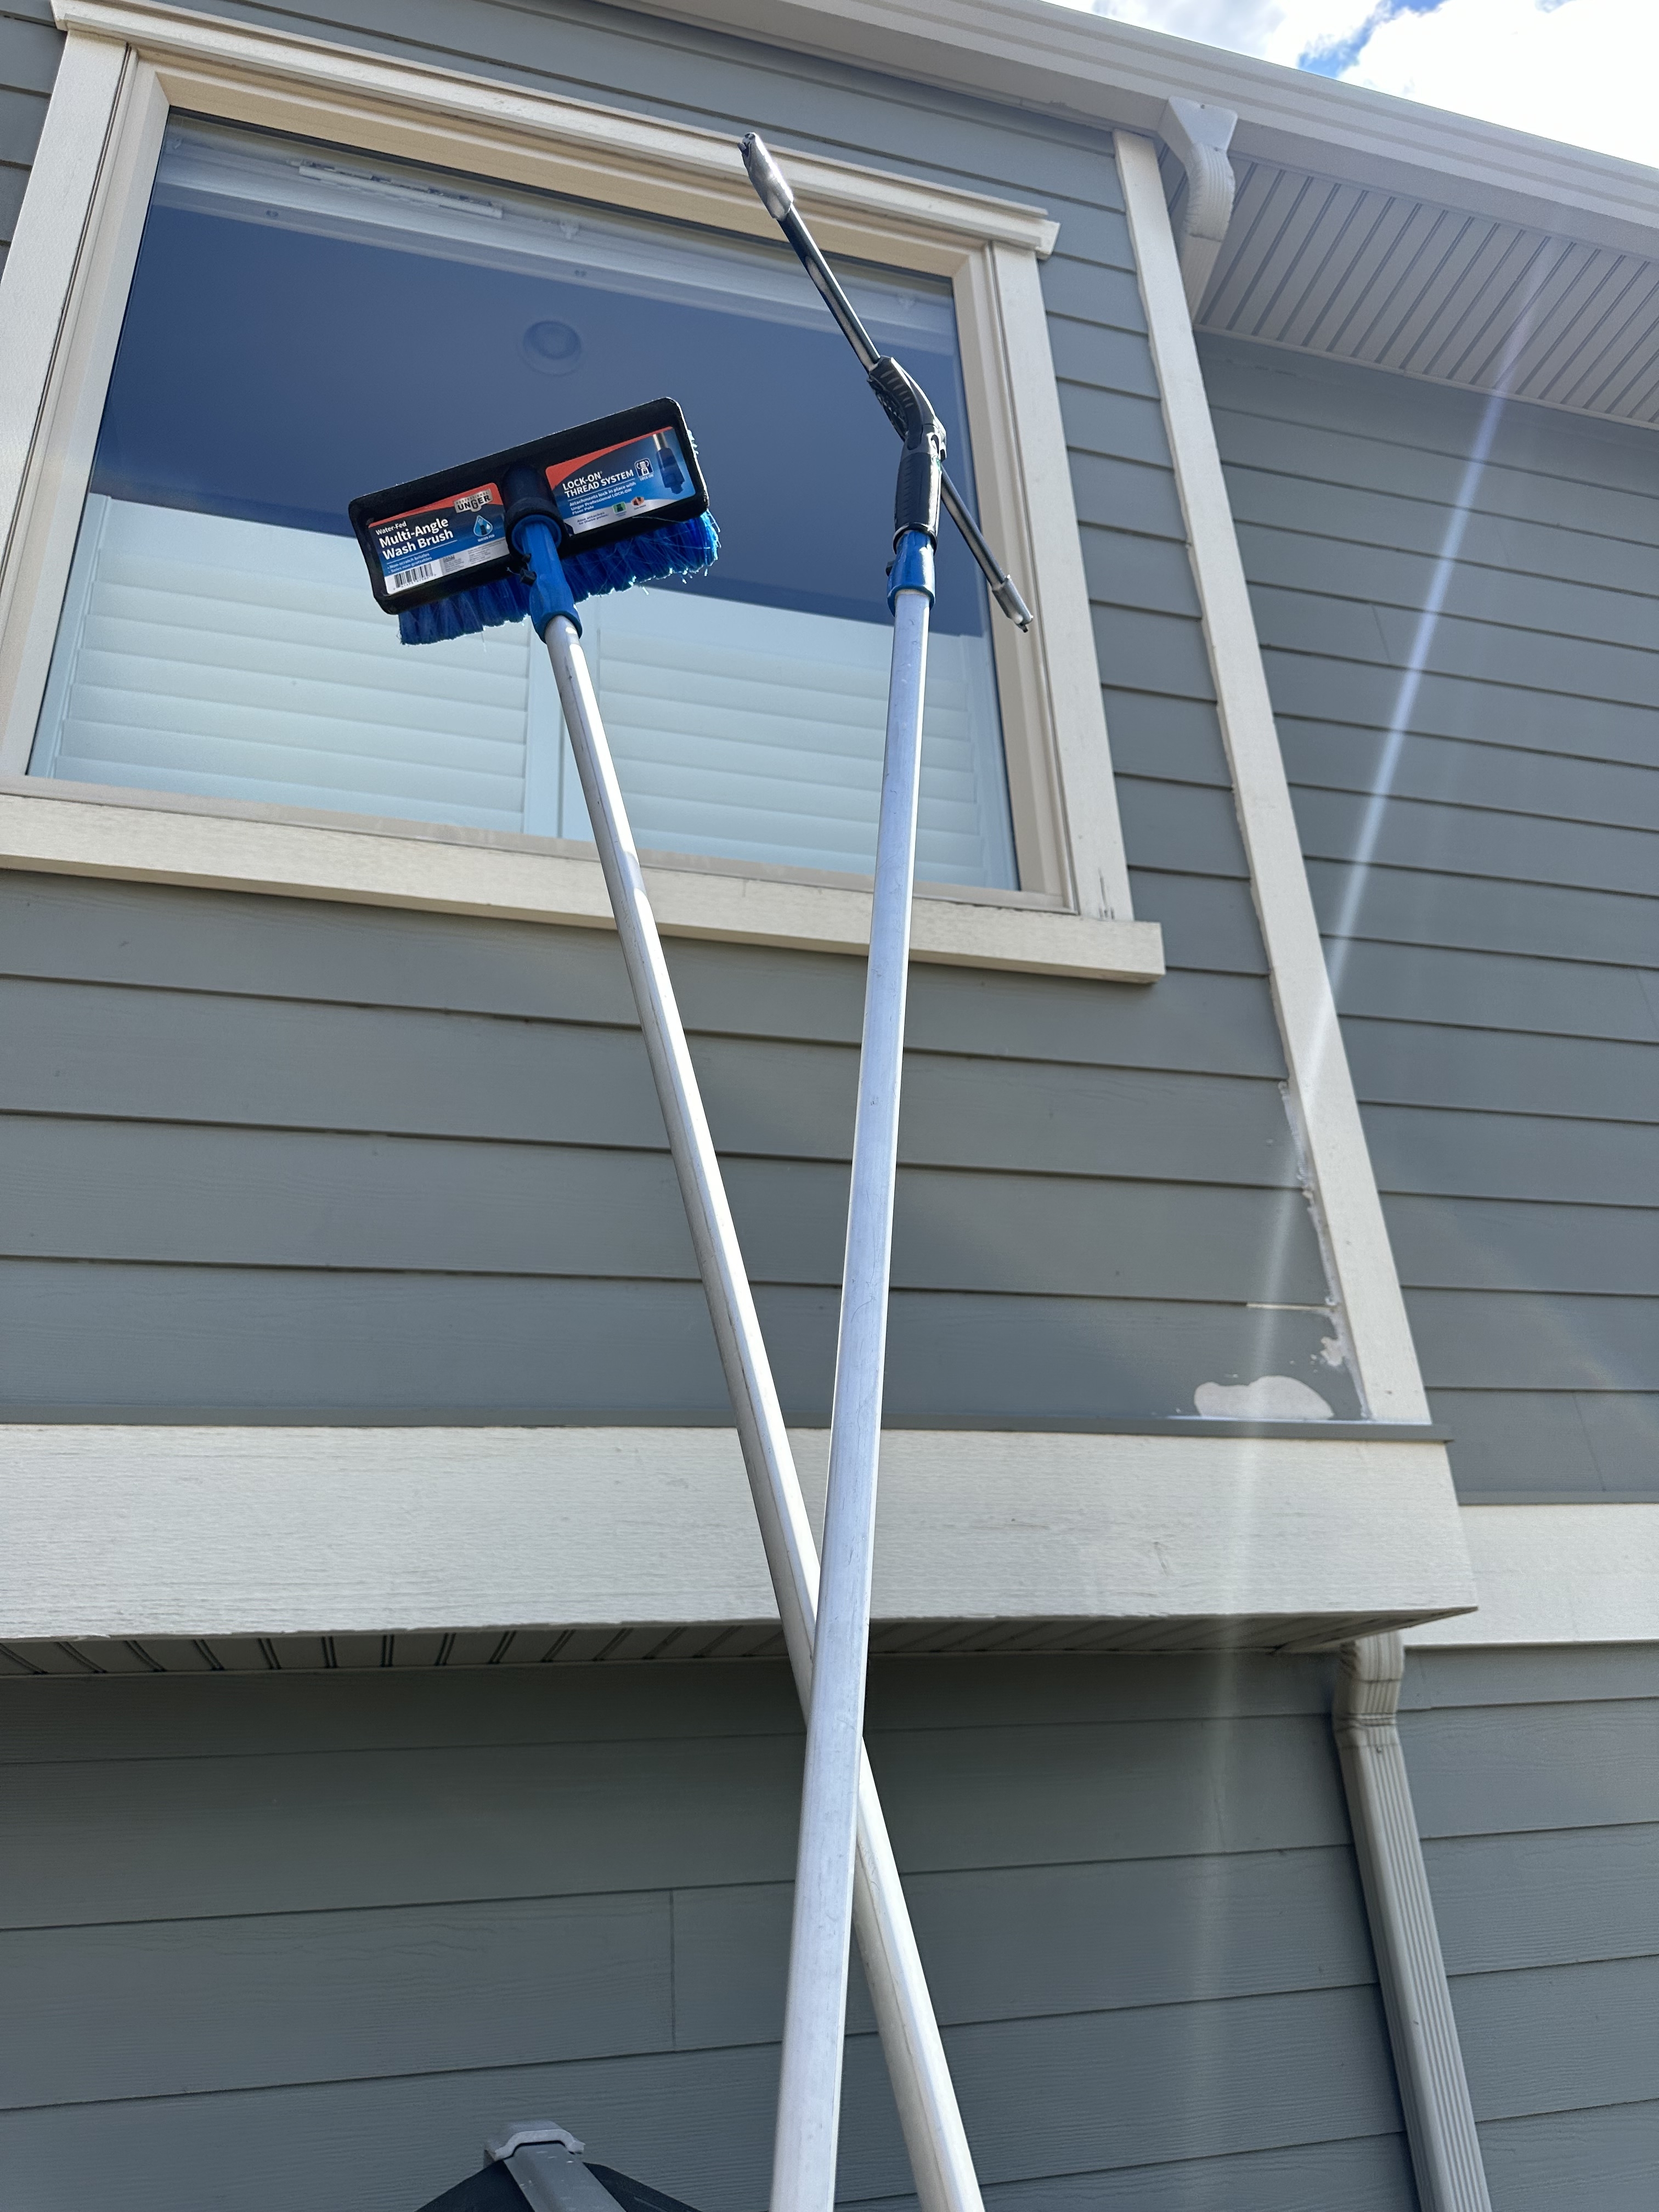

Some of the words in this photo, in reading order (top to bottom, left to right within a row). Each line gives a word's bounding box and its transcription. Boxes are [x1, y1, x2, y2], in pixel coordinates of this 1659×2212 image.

[565, 482, 599, 498] THREAD
[601, 470, 634, 486] SYSTEM
[458, 495, 490, 510] UNGER
[570, 494, 598, 506] Attachments
[613, 485, 625, 493] place
[585, 496, 611, 507] Professional
[376, 521, 407, 535] Water-Fed
[379, 518, 449, 548] Multi-Angle
[382, 542, 416, 560] Wash
[417, 529, 453, 548] Brush
